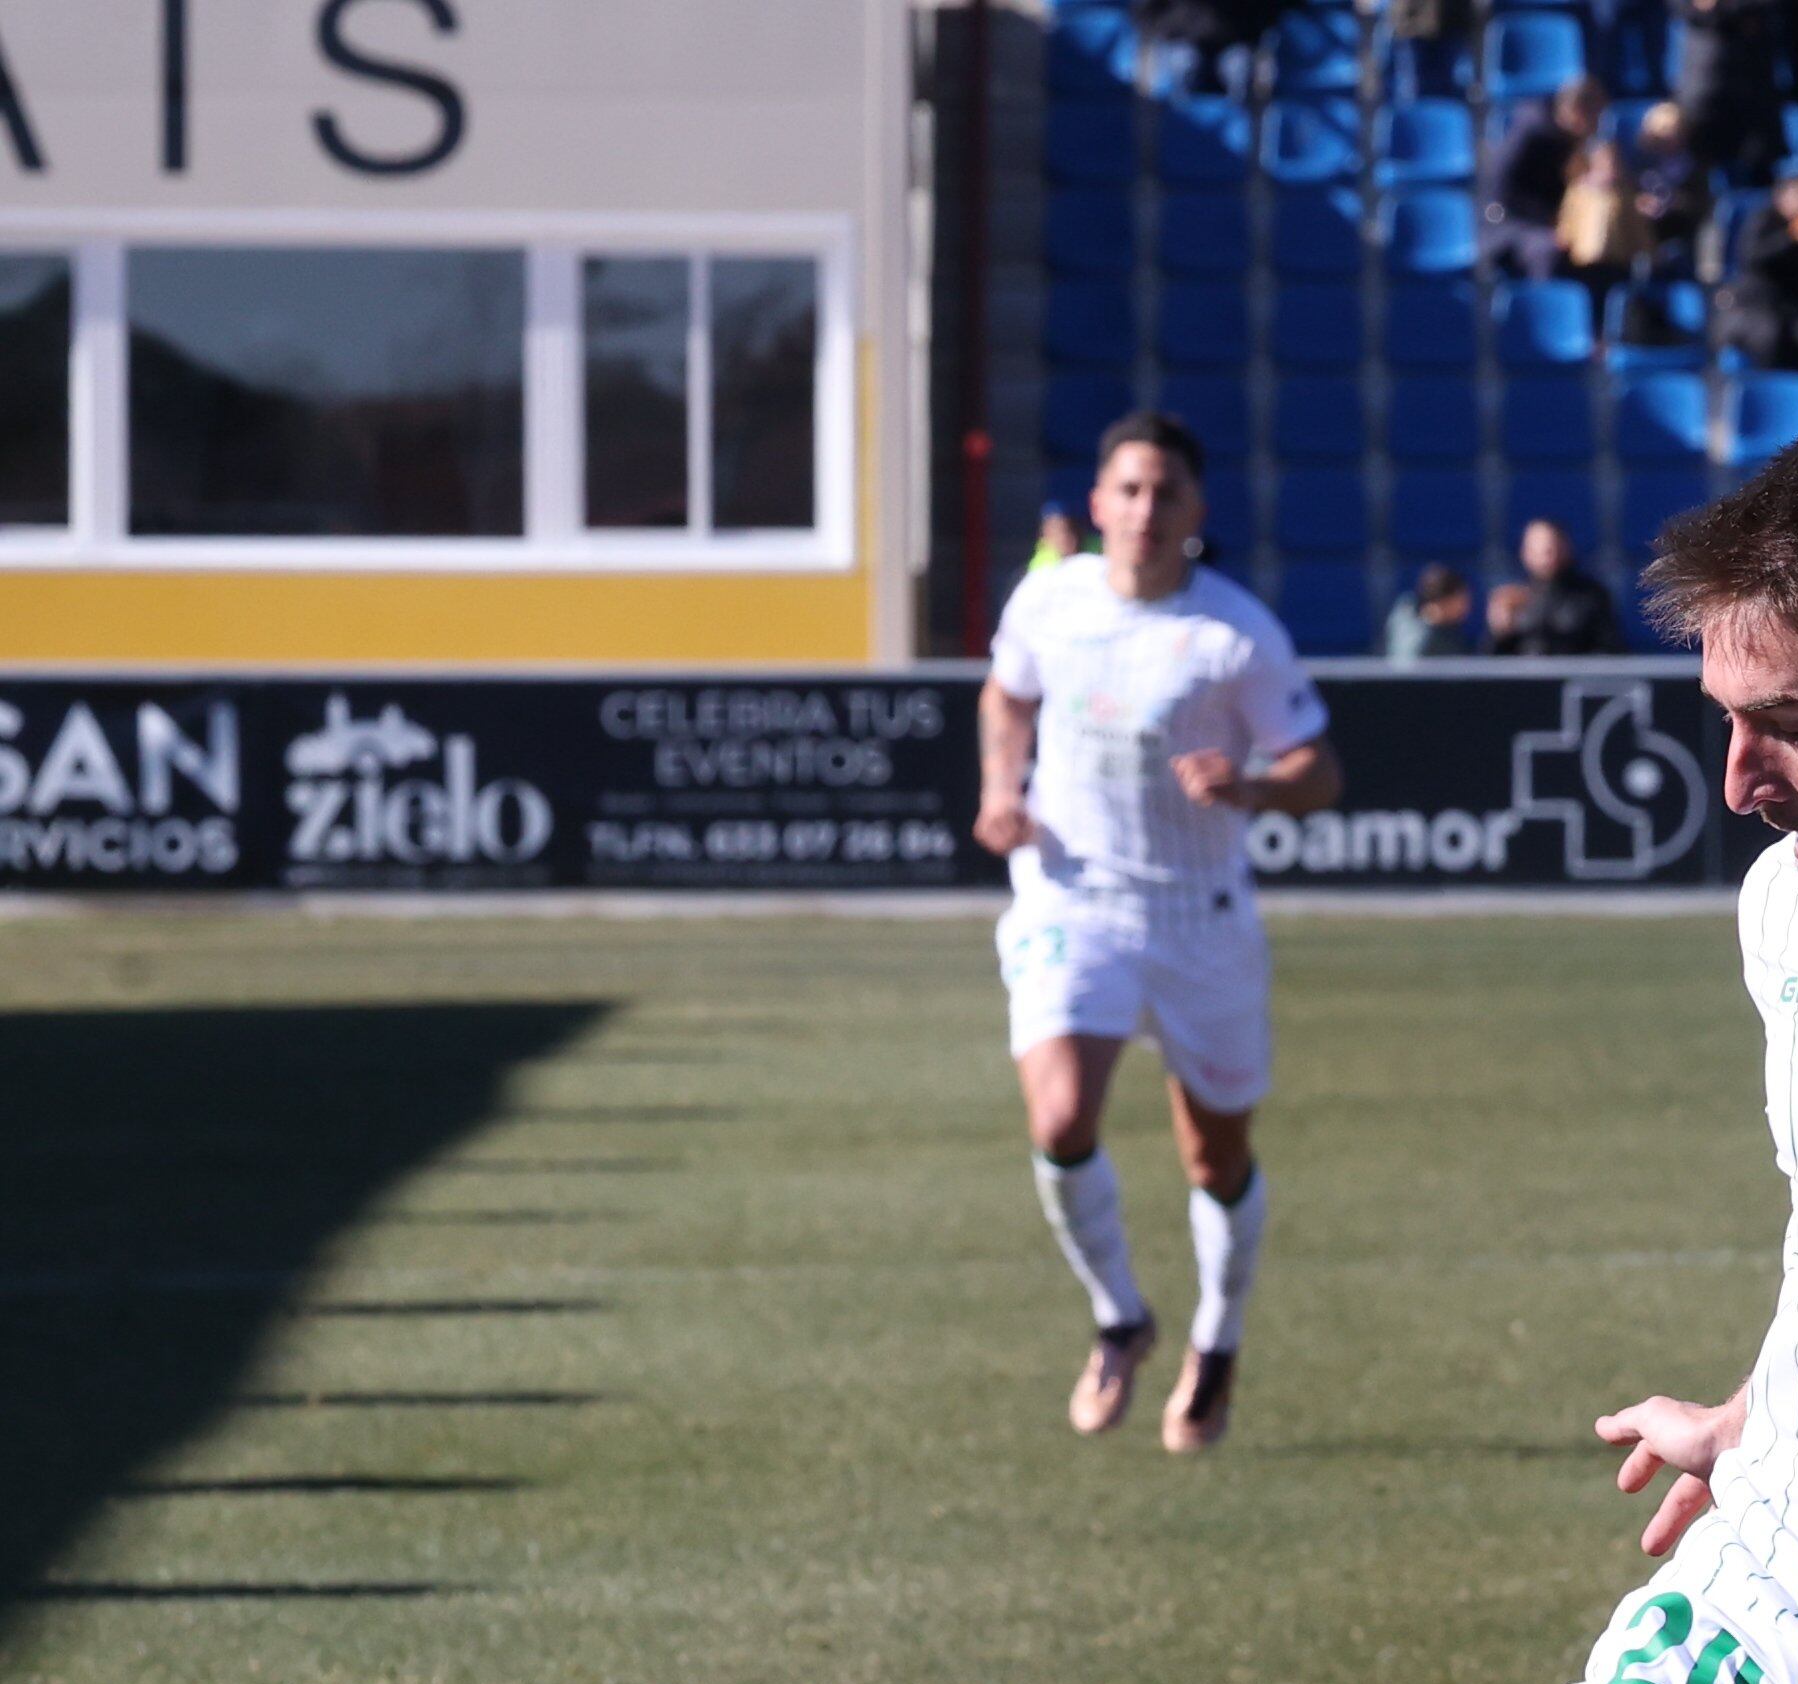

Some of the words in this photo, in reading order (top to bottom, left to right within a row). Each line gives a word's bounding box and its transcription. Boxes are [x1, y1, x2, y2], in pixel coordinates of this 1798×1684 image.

[600, 689, 837, 739] CELEBRA
[848, 689, 944, 739] TUS
[653, 737, 894, 787] EVENTOS
